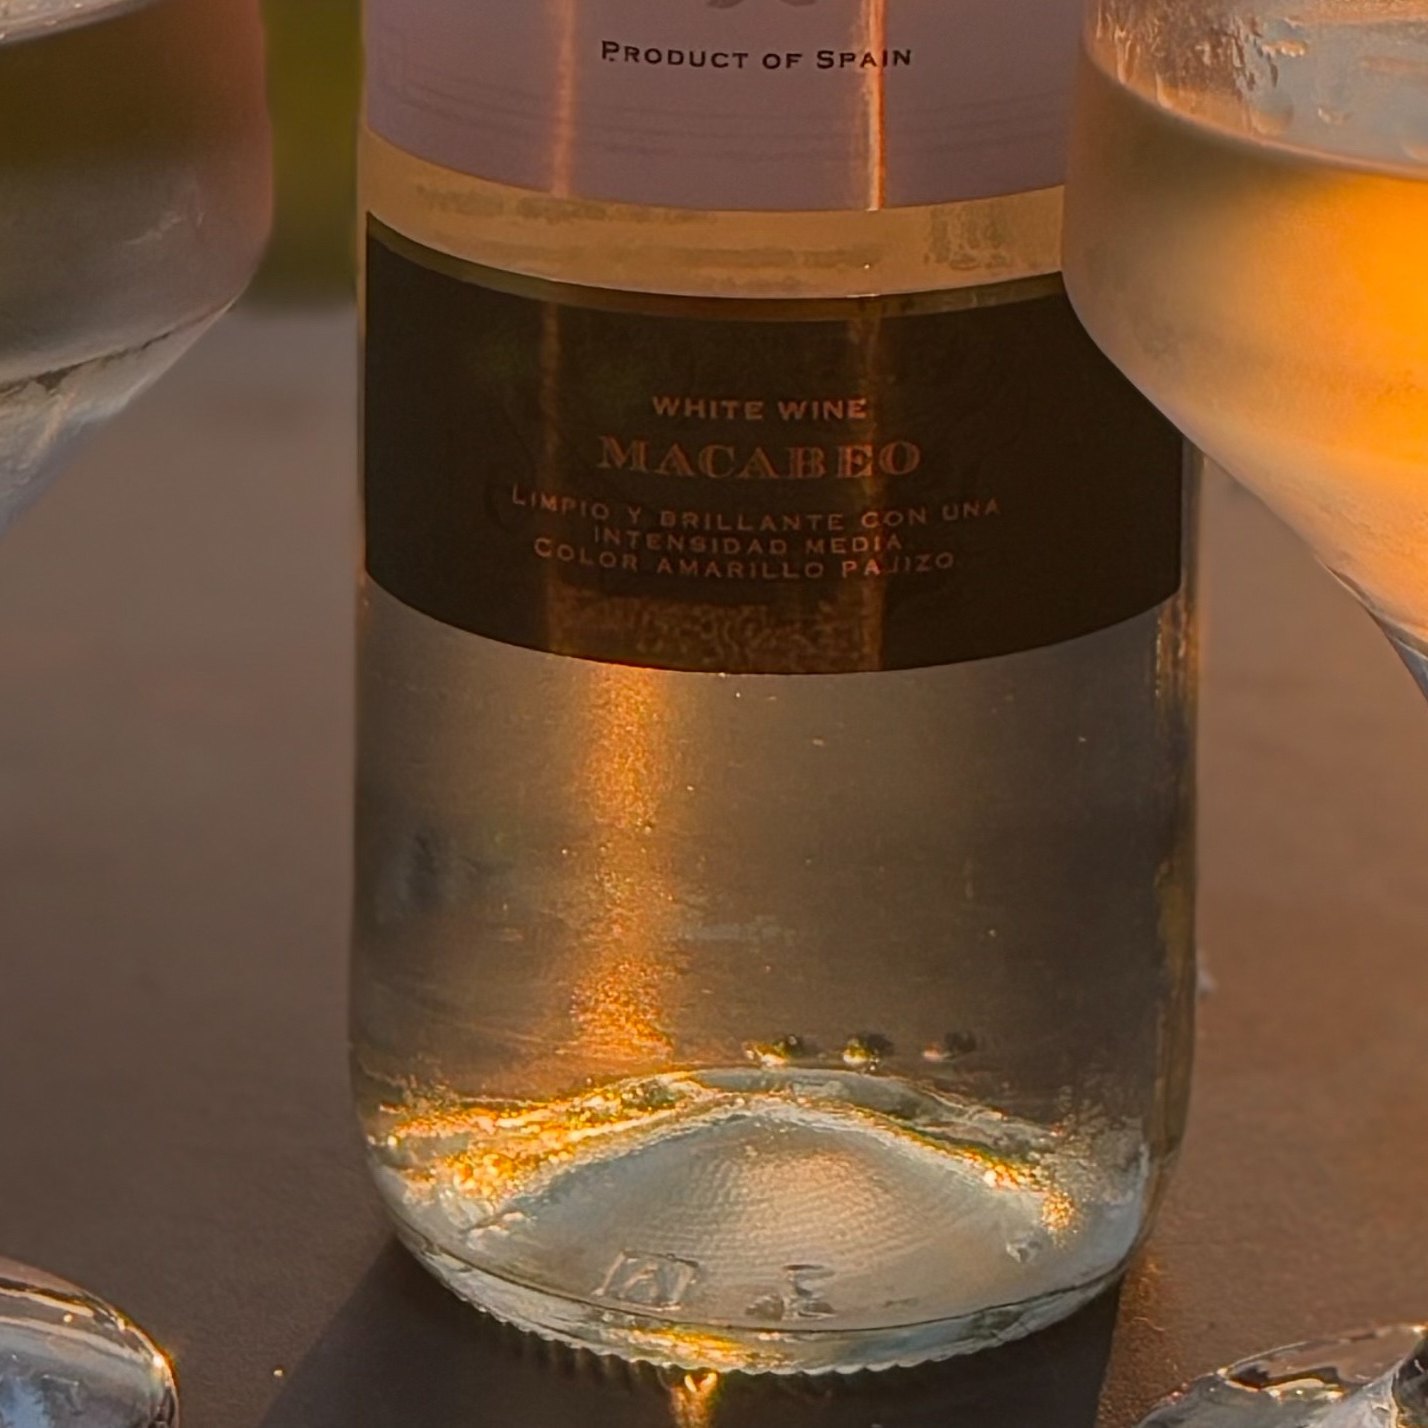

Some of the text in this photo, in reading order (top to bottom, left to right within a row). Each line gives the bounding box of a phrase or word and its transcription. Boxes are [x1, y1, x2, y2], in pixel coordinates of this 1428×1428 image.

[600, 40, 913, 71] PRODUCT OF SPAIN
[652, 395, 868, 421] WHITE WINE
[597, 435, 922, 480] MACABEO
[511, 482, 1000, 532] LIMPIO Y BRILLANTE CON UNA
[533, 537, 955, 579] COLOR AMARILLO PAJIZO
[593, 526, 903, 555] INTENSIDAD MEDIA
